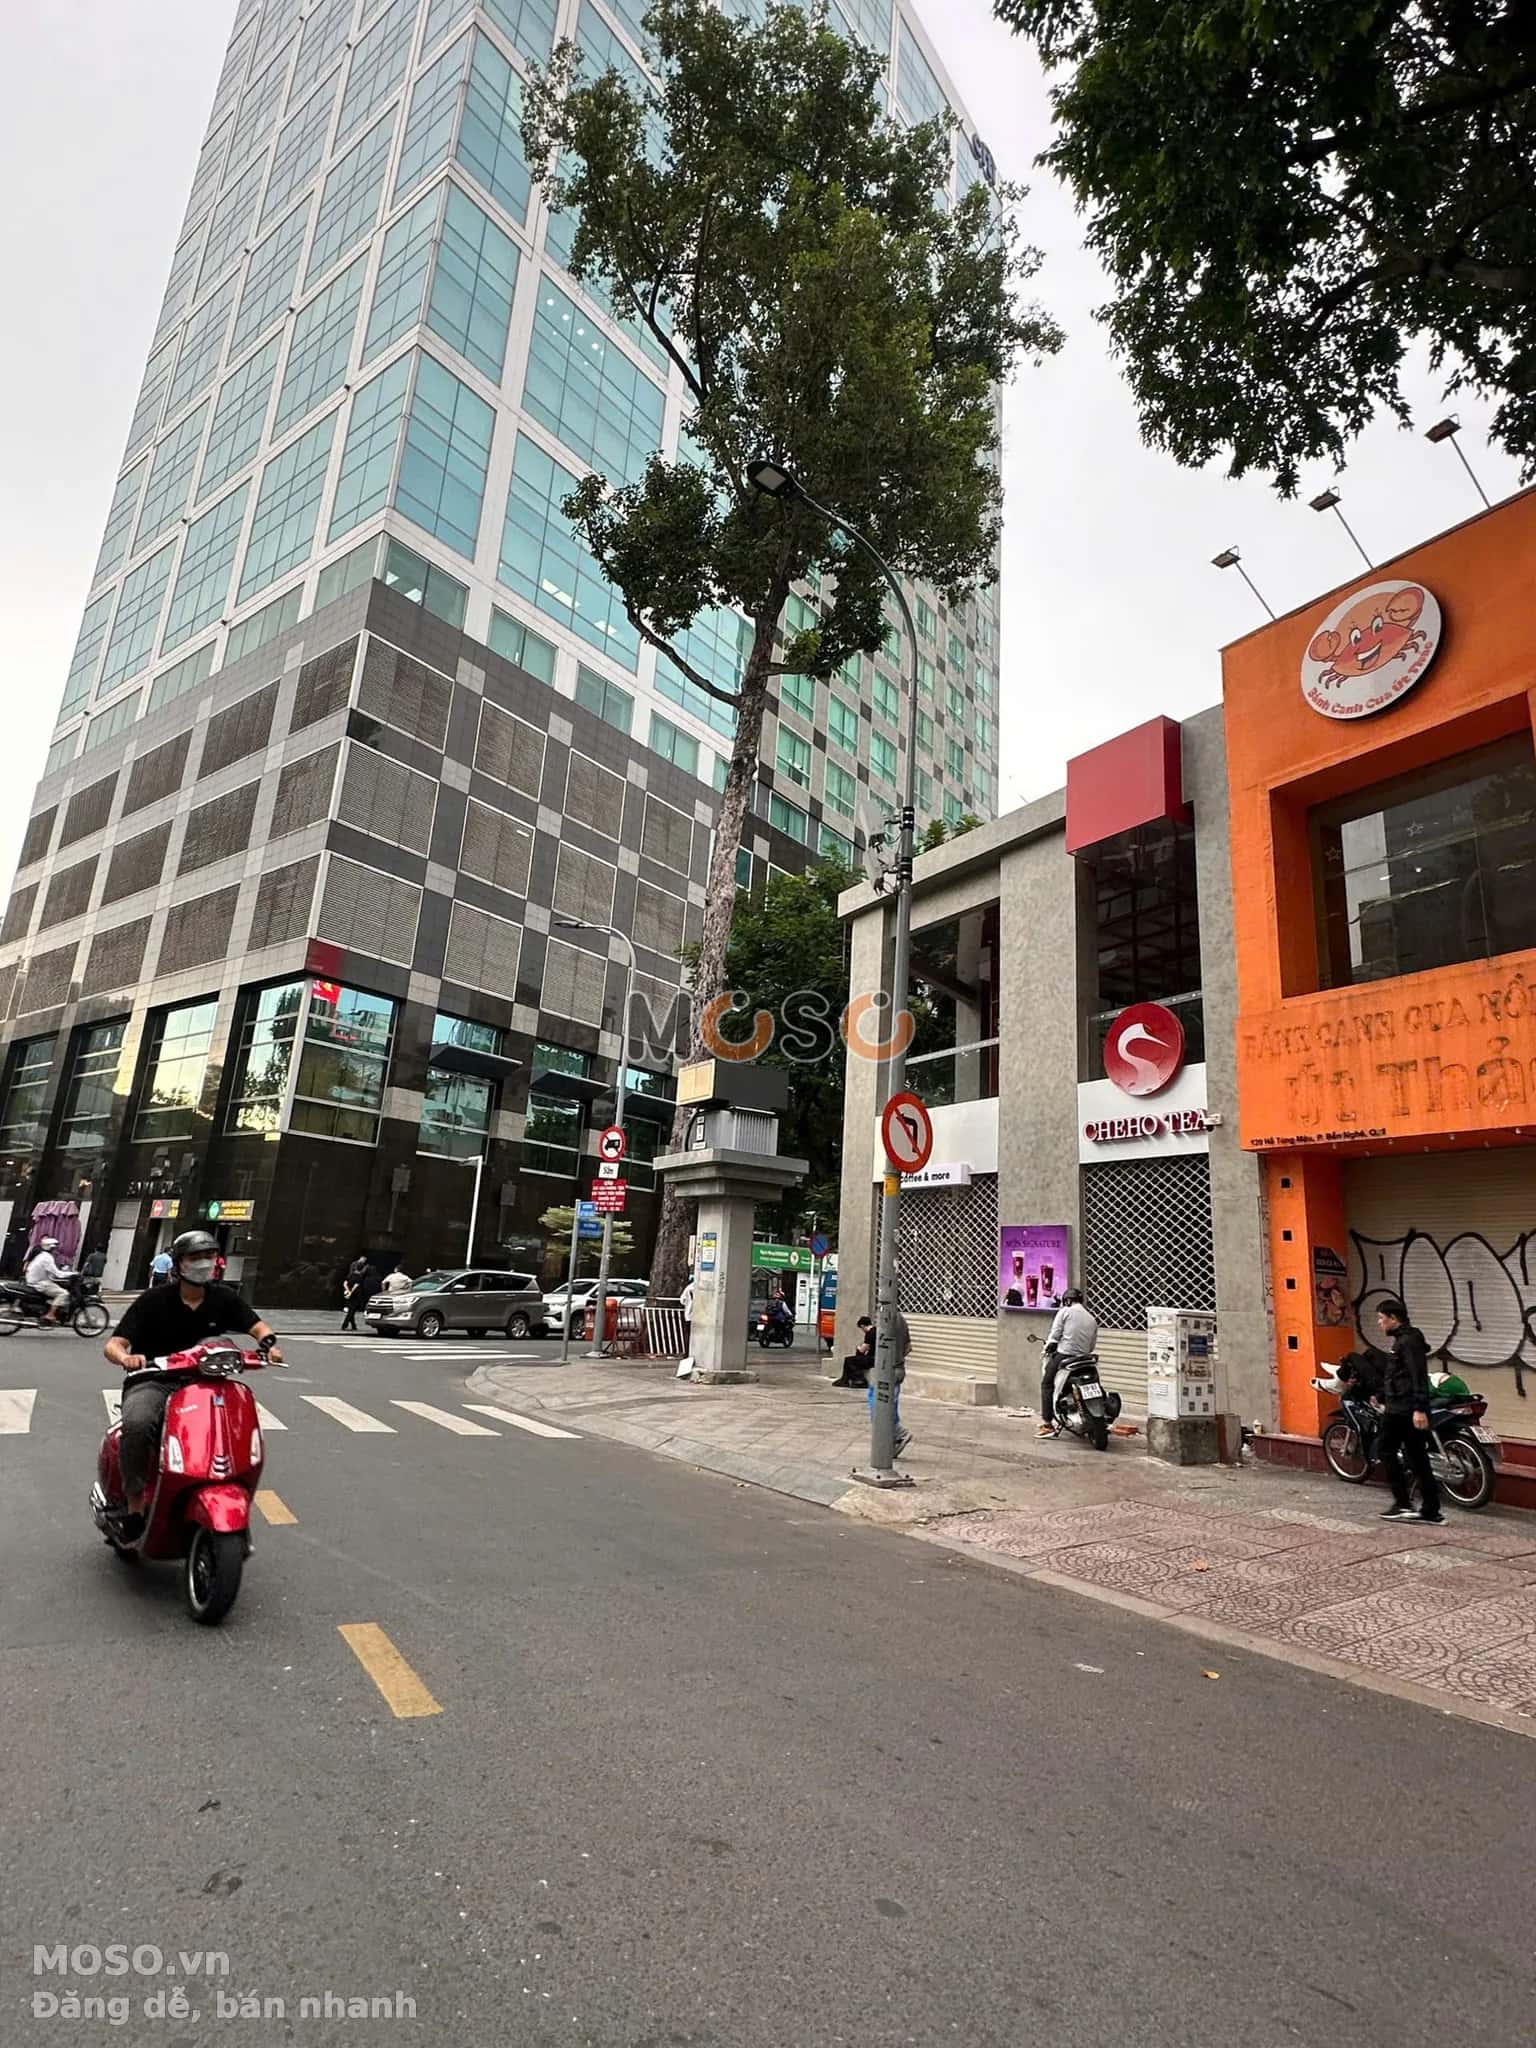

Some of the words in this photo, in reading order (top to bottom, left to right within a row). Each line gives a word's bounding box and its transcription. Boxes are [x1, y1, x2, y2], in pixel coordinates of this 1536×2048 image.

[1308, 688, 1329, 711] Bánh
[1331, 703, 1363, 714] Canh
[1365, 692, 1393, 709] Cua
[1404, 998, 1470, 1034] CUA
[1376, 1035, 1536, 1118] Thả
[1083, 1113, 1160, 1142] CHEHO
[1162, 1108, 1209, 1134] TEA
[931, 1171, 950, 1181] more
